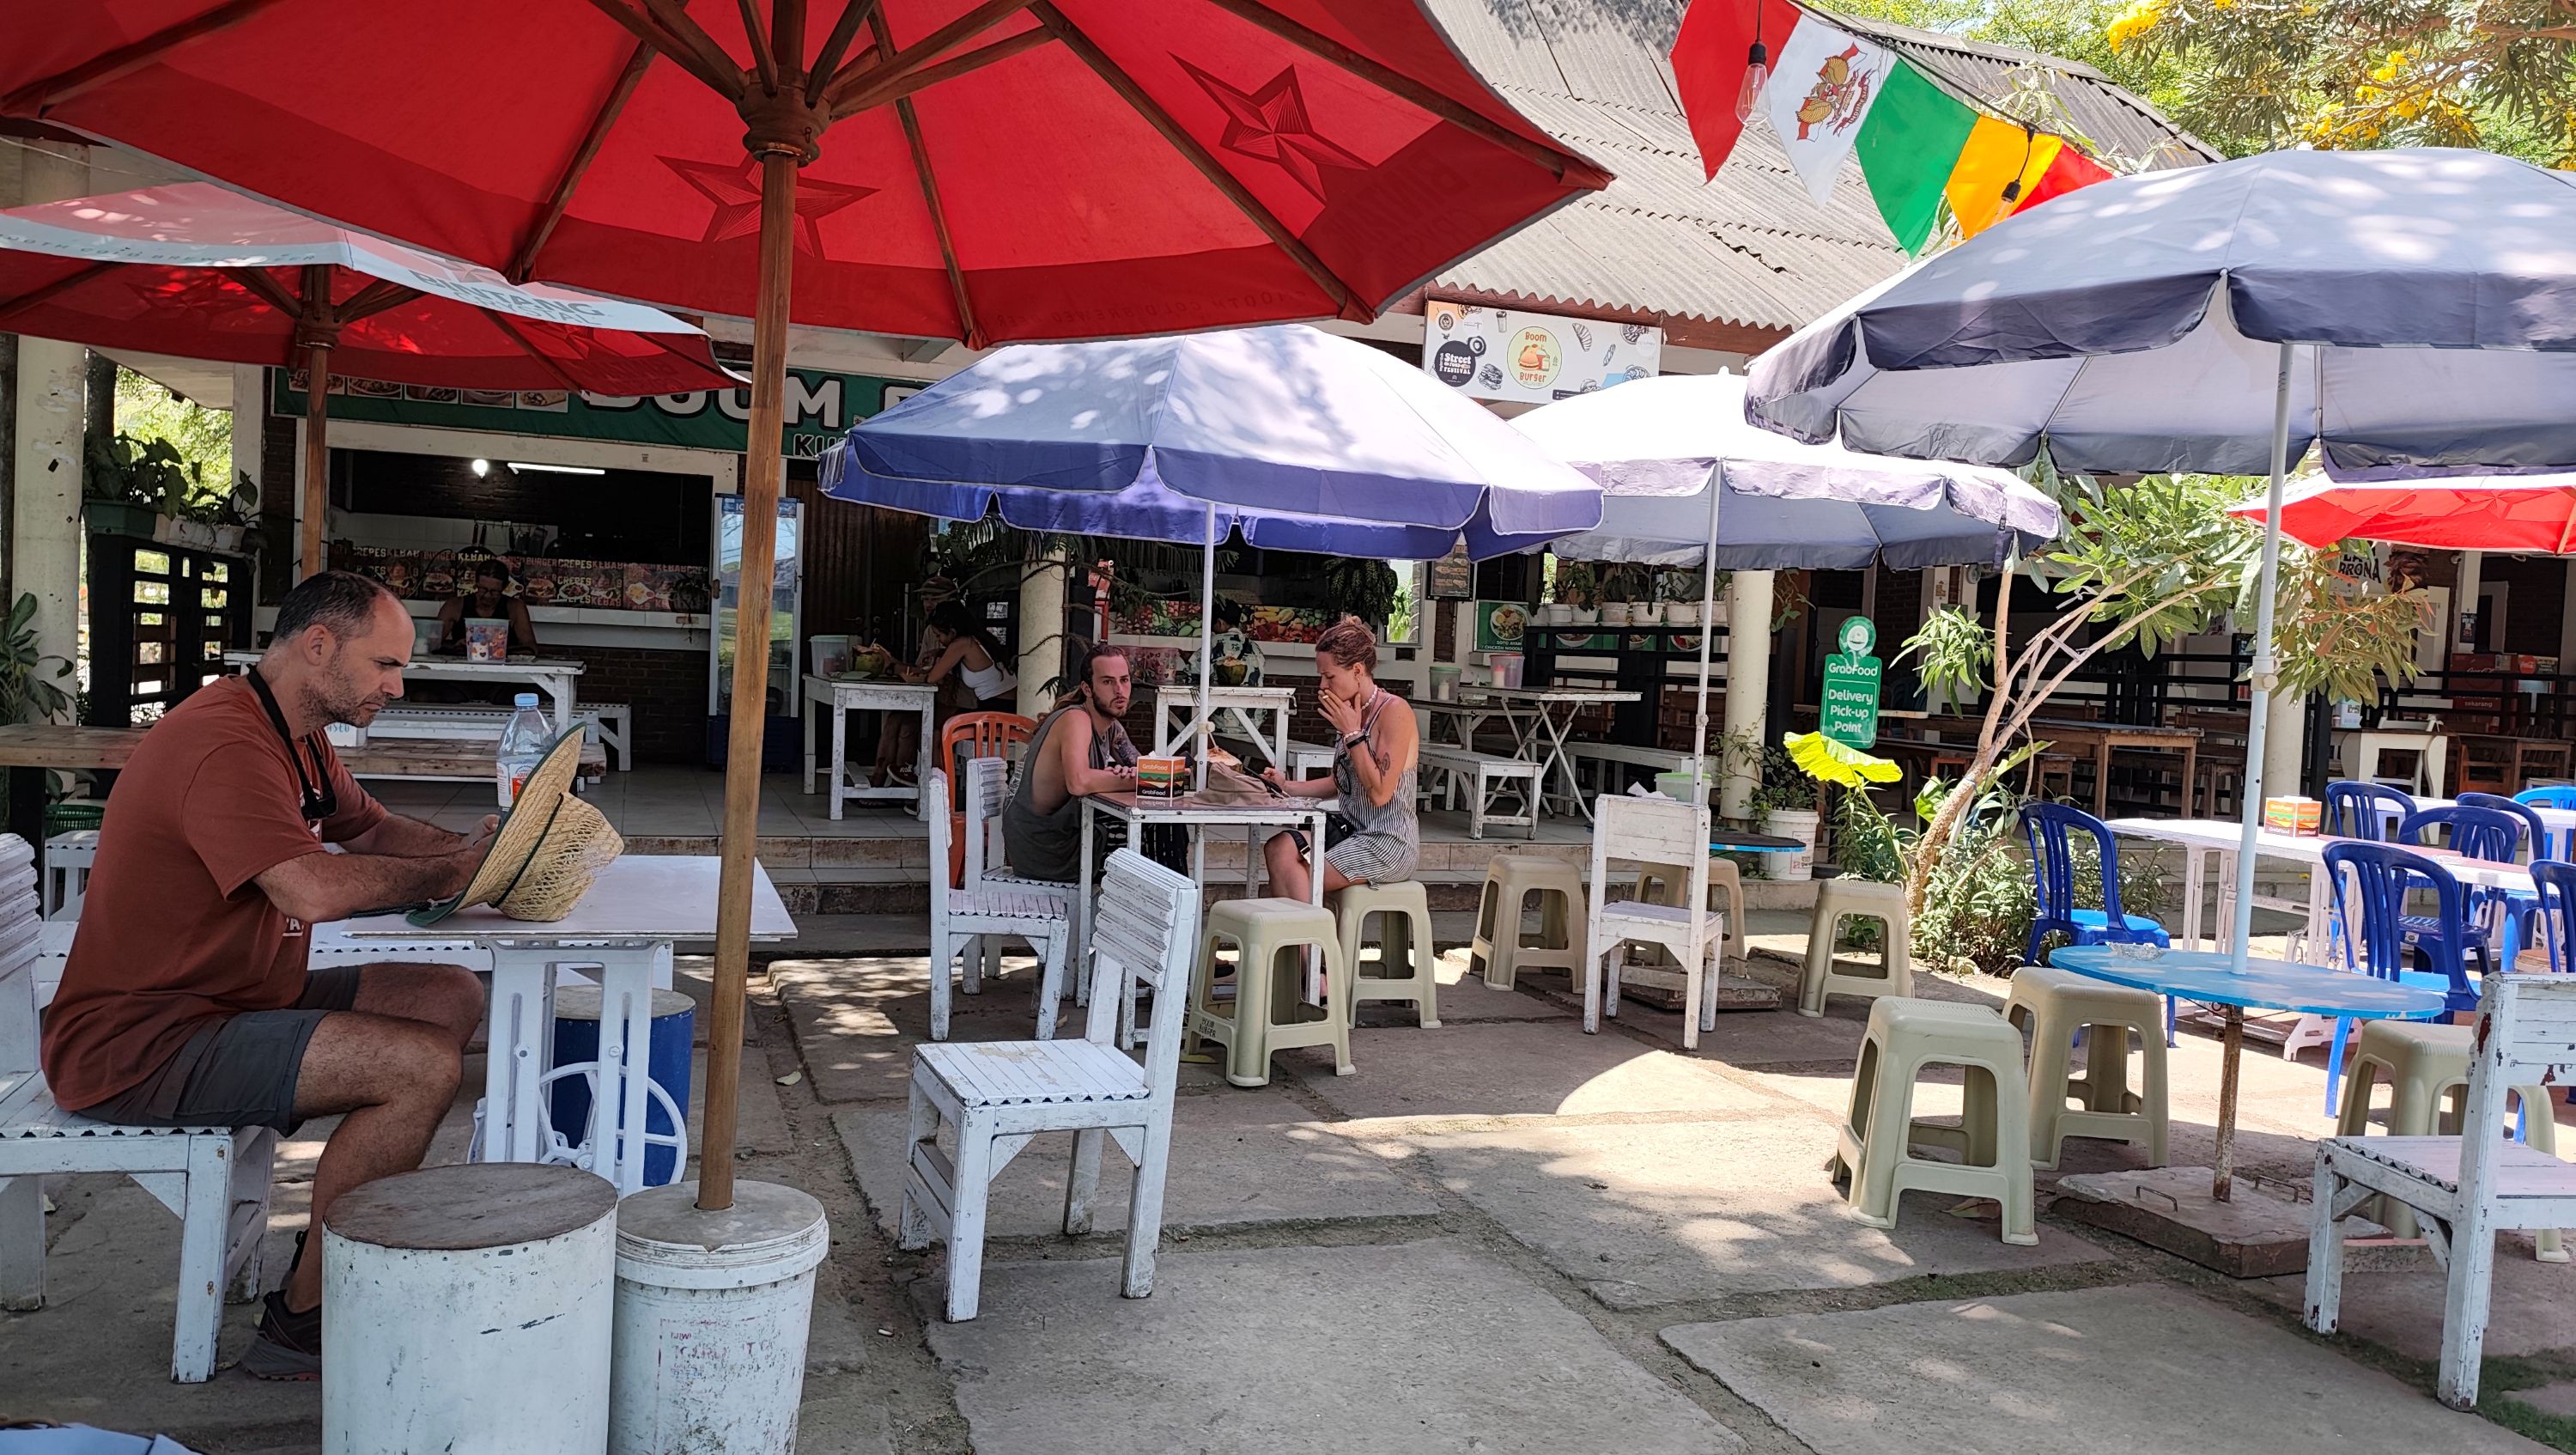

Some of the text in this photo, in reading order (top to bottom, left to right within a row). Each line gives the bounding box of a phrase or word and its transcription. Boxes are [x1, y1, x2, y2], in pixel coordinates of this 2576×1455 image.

[1848, 85, 1869, 125] INDONESIA
[414, 271, 605, 317] BINTANG
[453, 291, 602, 326] CRYSTAL
[1524, 332, 1547, 343] Boom
[1444, 352, 1472, 365] Street
[1443, 367, 1471, 375] FESTIVAL
[1519, 371, 1547, 383] Burger
[558, 558, 592, 569] CREPES
[1828, 662, 1879, 677] GrabFood
[1827, 689, 1874, 706] Delivery
[2464, 697, 2493, 708] sekarang
[1829, 704, 1869, 721] Pick-up
[1833, 721, 1863, 734] Point
